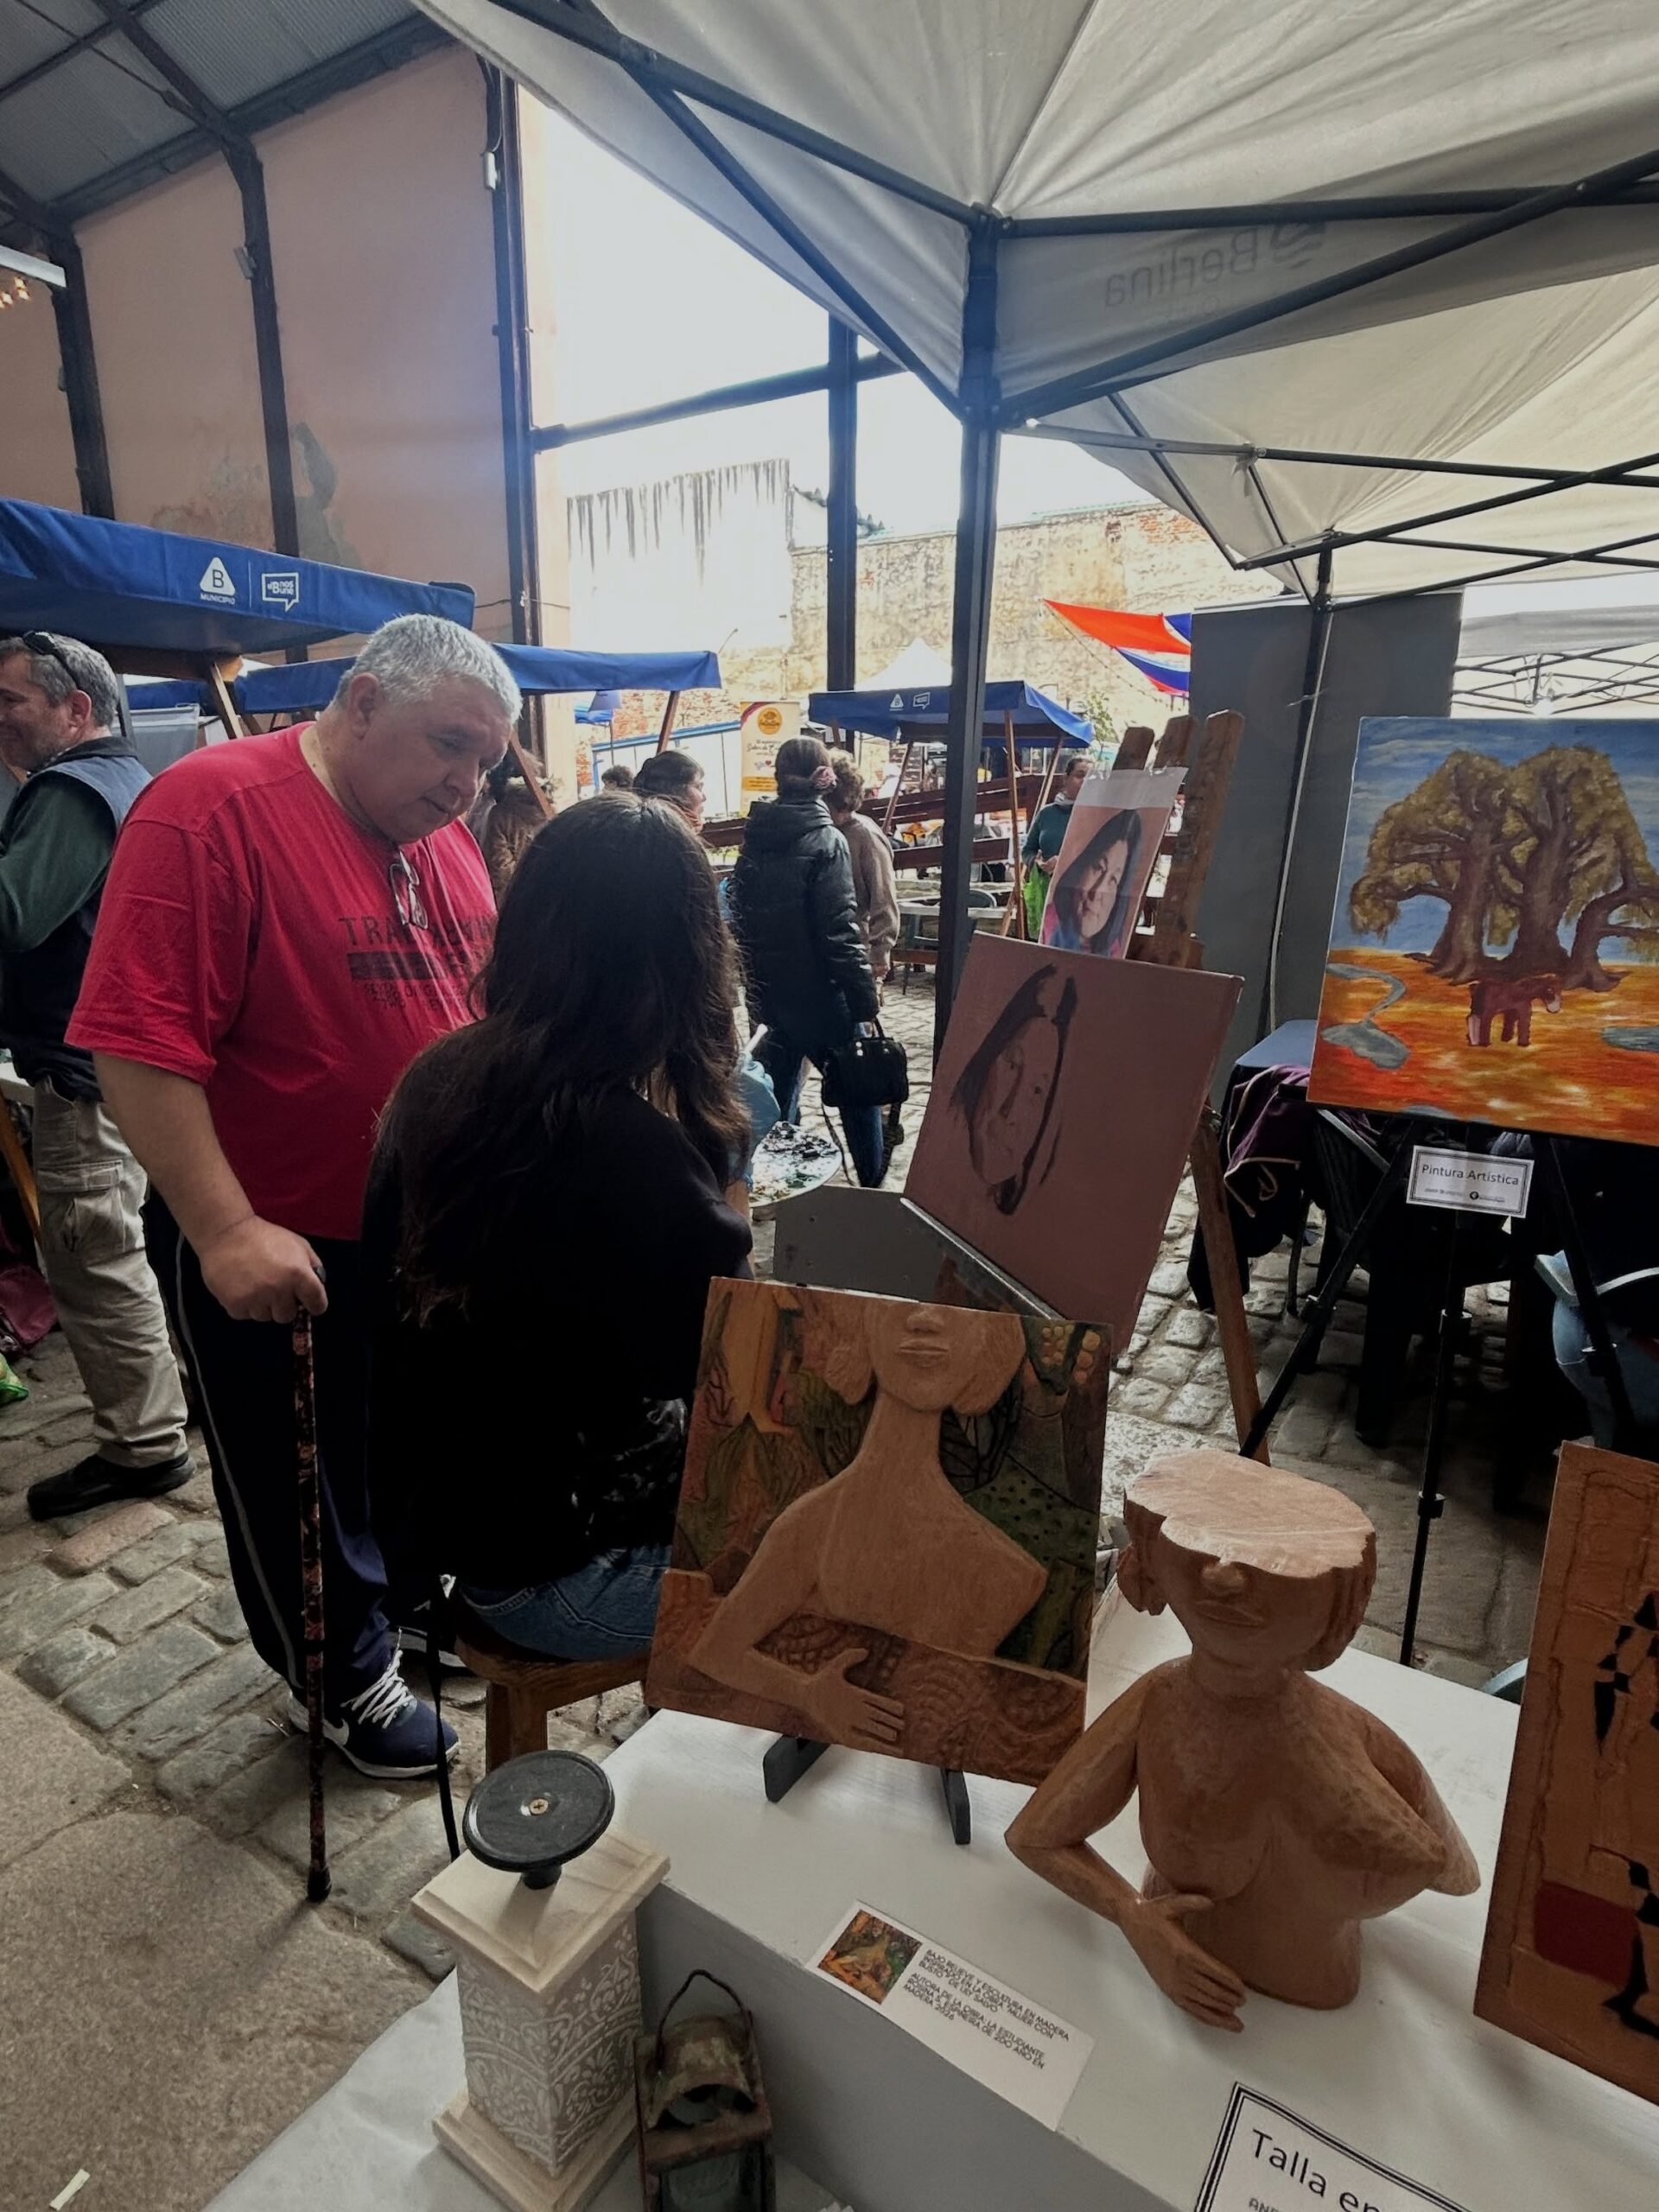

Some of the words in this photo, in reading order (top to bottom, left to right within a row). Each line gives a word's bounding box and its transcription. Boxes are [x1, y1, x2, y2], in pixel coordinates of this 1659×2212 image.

[213, 569, 225, 588] B
[200, 593, 236, 605] MUNICIPIO
[1421, 1164, 1464, 1179] Pintura
[918, 1960, 944, 1979] BUSTO
[948, 1978, 960, 1989] DE
[902, 1982, 935, 2006] MADERA
[911, 1971, 941, 1993] AUTORA
[941, 1990, 952, 1999] DE
[952, 1998, 963, 2007] LA
[987, 2019, 997, 2031] LA
[926, 1948, 945, 1963] BAJO
[945, 1961, 974, 1980] RELIEVE
[982, 1982, 1024, 2012] ESCULTURA
[1024, 2007, 1036, 2018] EN
[1035, 2015, 1071, 2041] MADERA
[961, 1978, 971, 1987] EN
[972, 1985, 982, 1994] LA
[982, 1991, 1005, 2008] OBRA
[1033, 2022, 1054, 2038] CON
[981, 2024, 994, 2037] DE
[1033, 2057, 1045, 2069] EN
[1253, 2128, 1327, 2198] Talla
